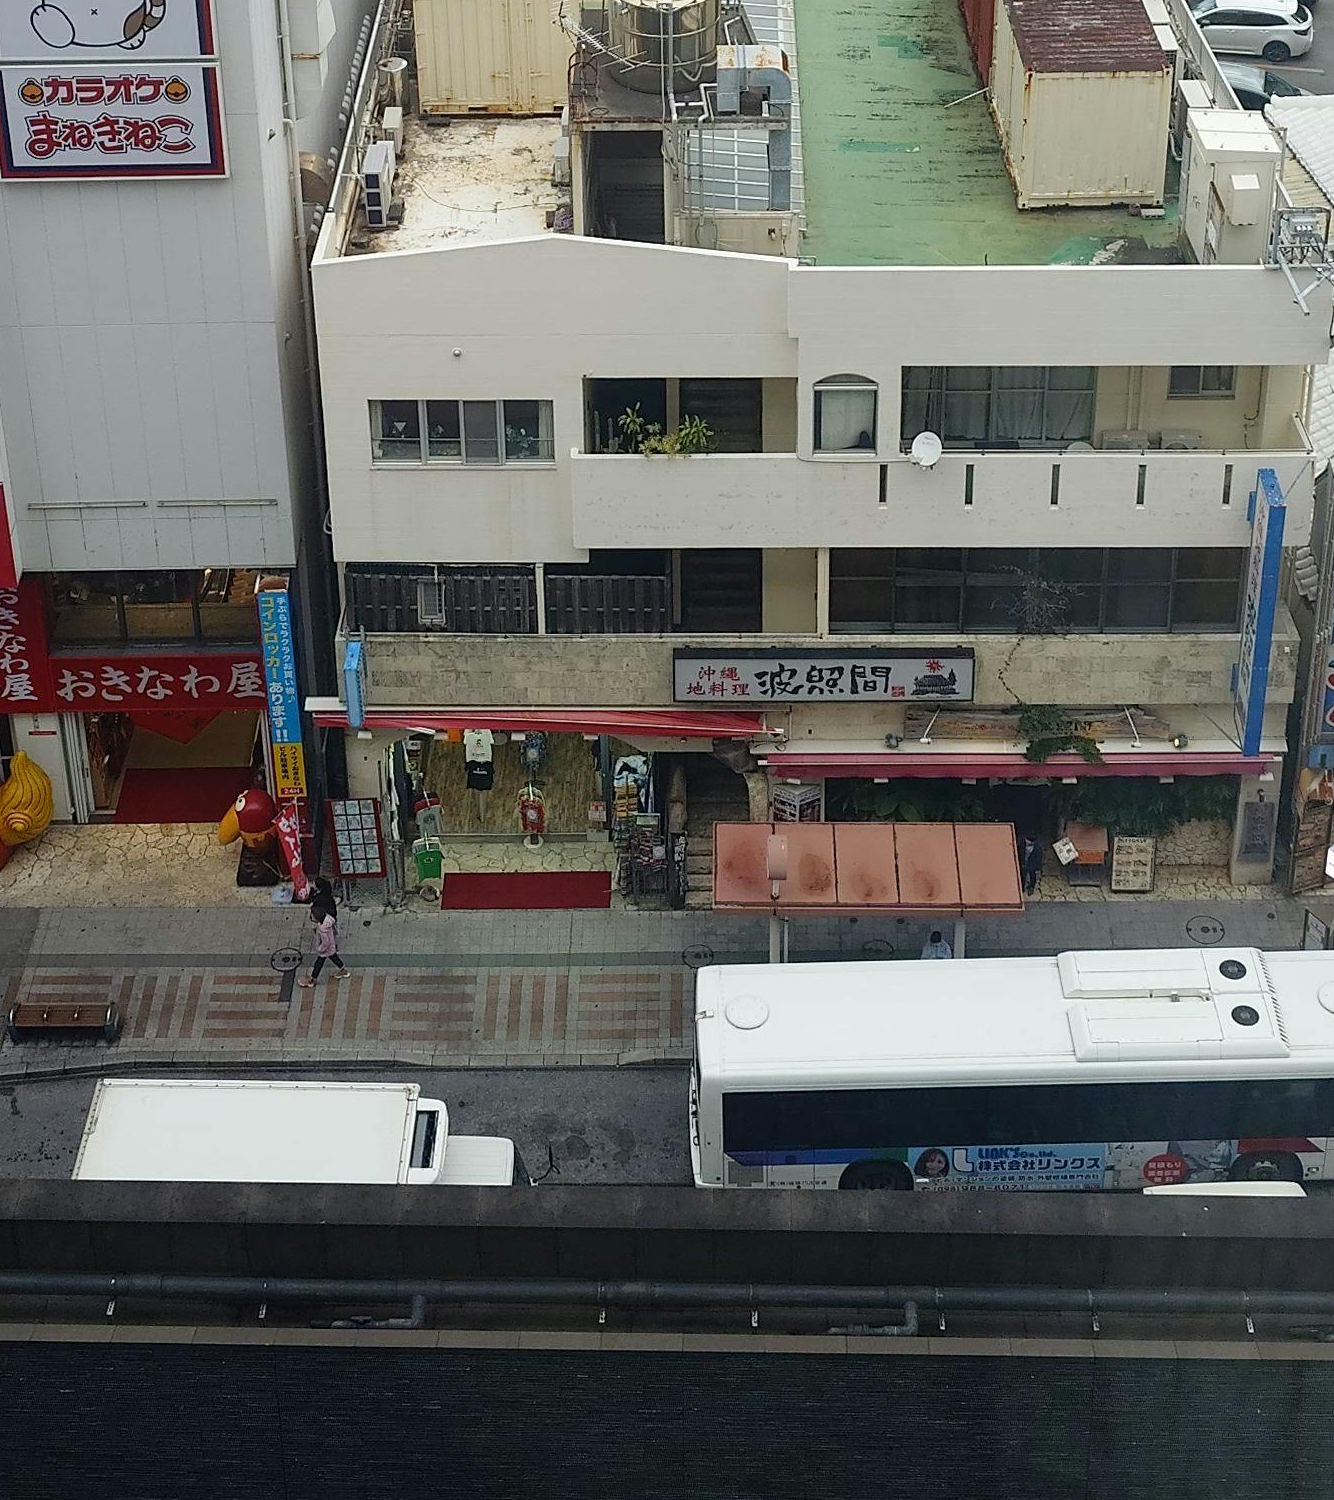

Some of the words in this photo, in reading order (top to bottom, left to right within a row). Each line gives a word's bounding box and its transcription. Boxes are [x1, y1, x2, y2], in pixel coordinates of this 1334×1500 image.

[43, 76, 167, 105] カラオケ
[24, 111, 197, 160] まねきねこ
[57, 661, 268, 700] おきなわ屋
[686, 681, 750, 697] 地料理
[697, 666, 741, 682] 沖縄
[754, 662, 893, 698] 波照間
